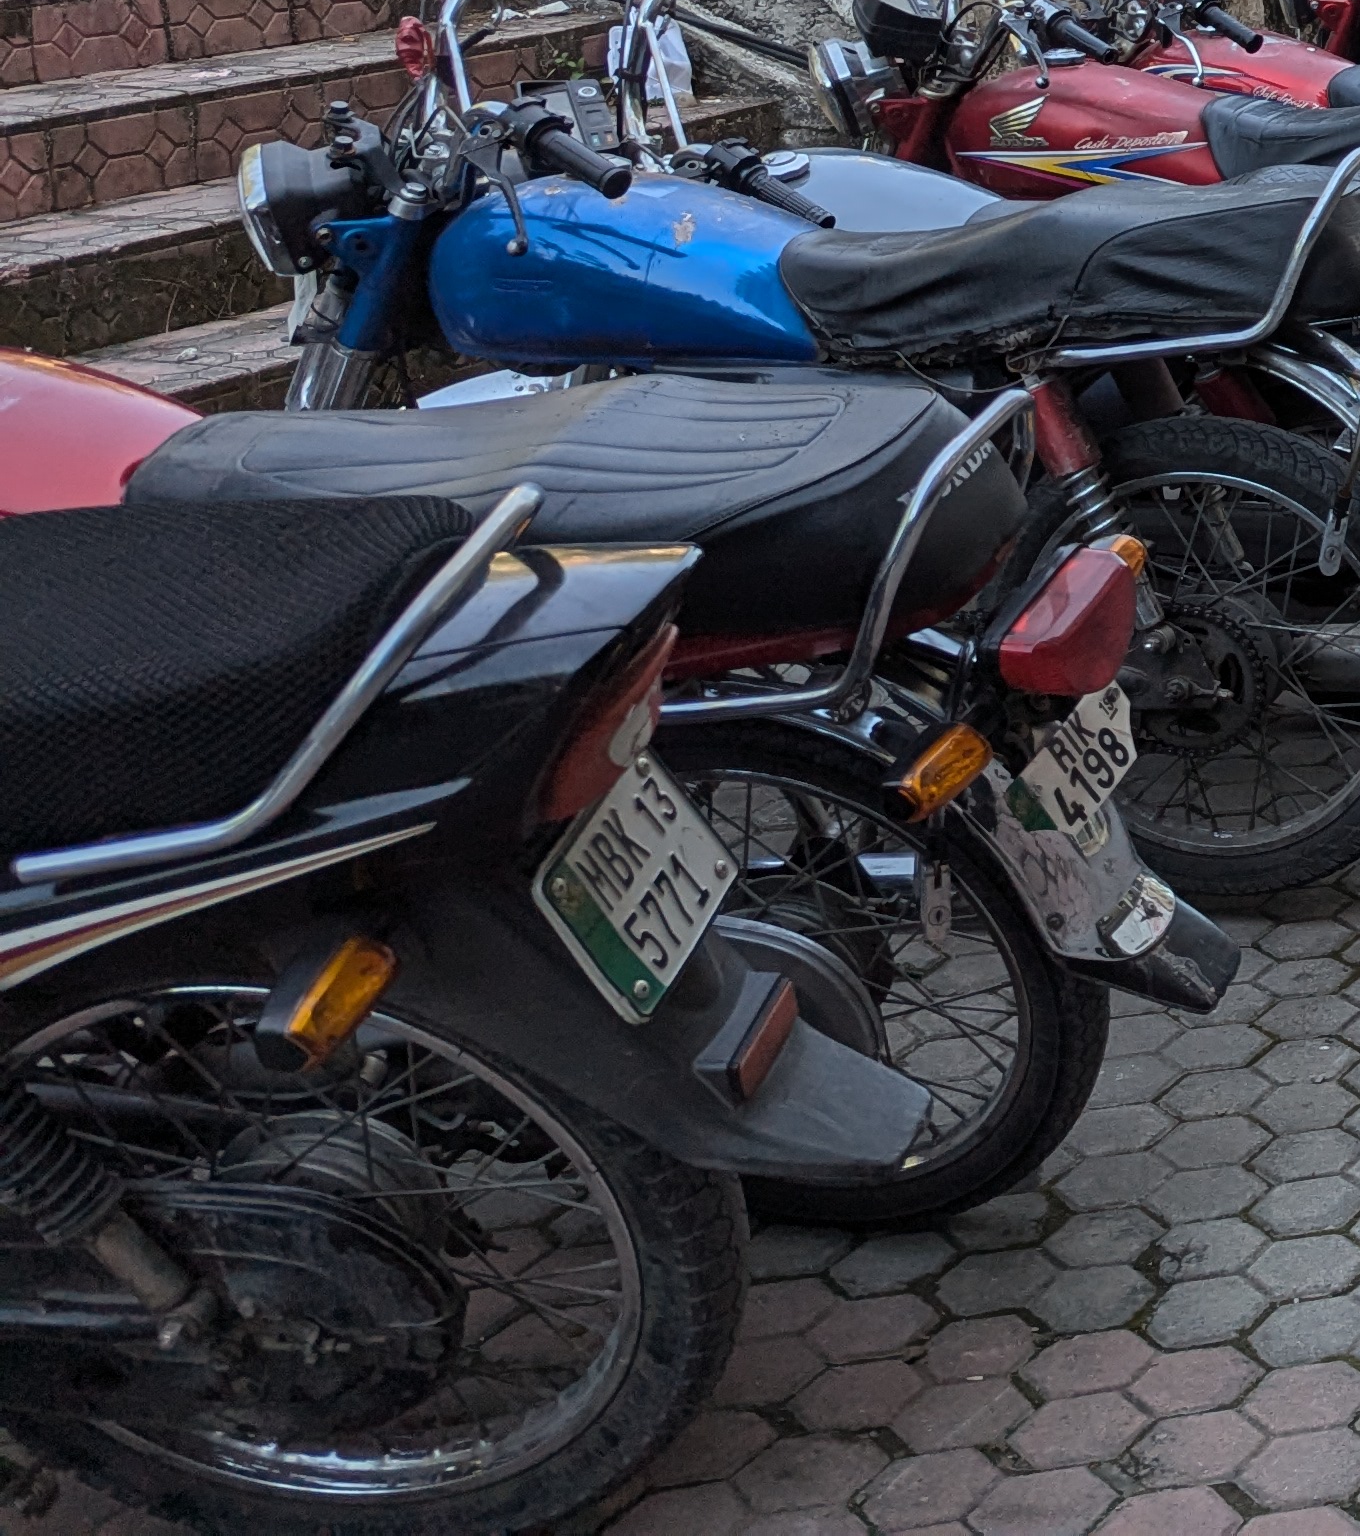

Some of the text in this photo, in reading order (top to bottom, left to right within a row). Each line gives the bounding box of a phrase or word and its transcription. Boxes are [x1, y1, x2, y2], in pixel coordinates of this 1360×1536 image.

[989, 135, 1049, 148] HONDA
[1074, 134, 1110, 150] Cash
[1051, 724, 1133, 829] 4198
[574, 771, 678, 911] MBK 13
[621, 847, 710, 970] 5771
